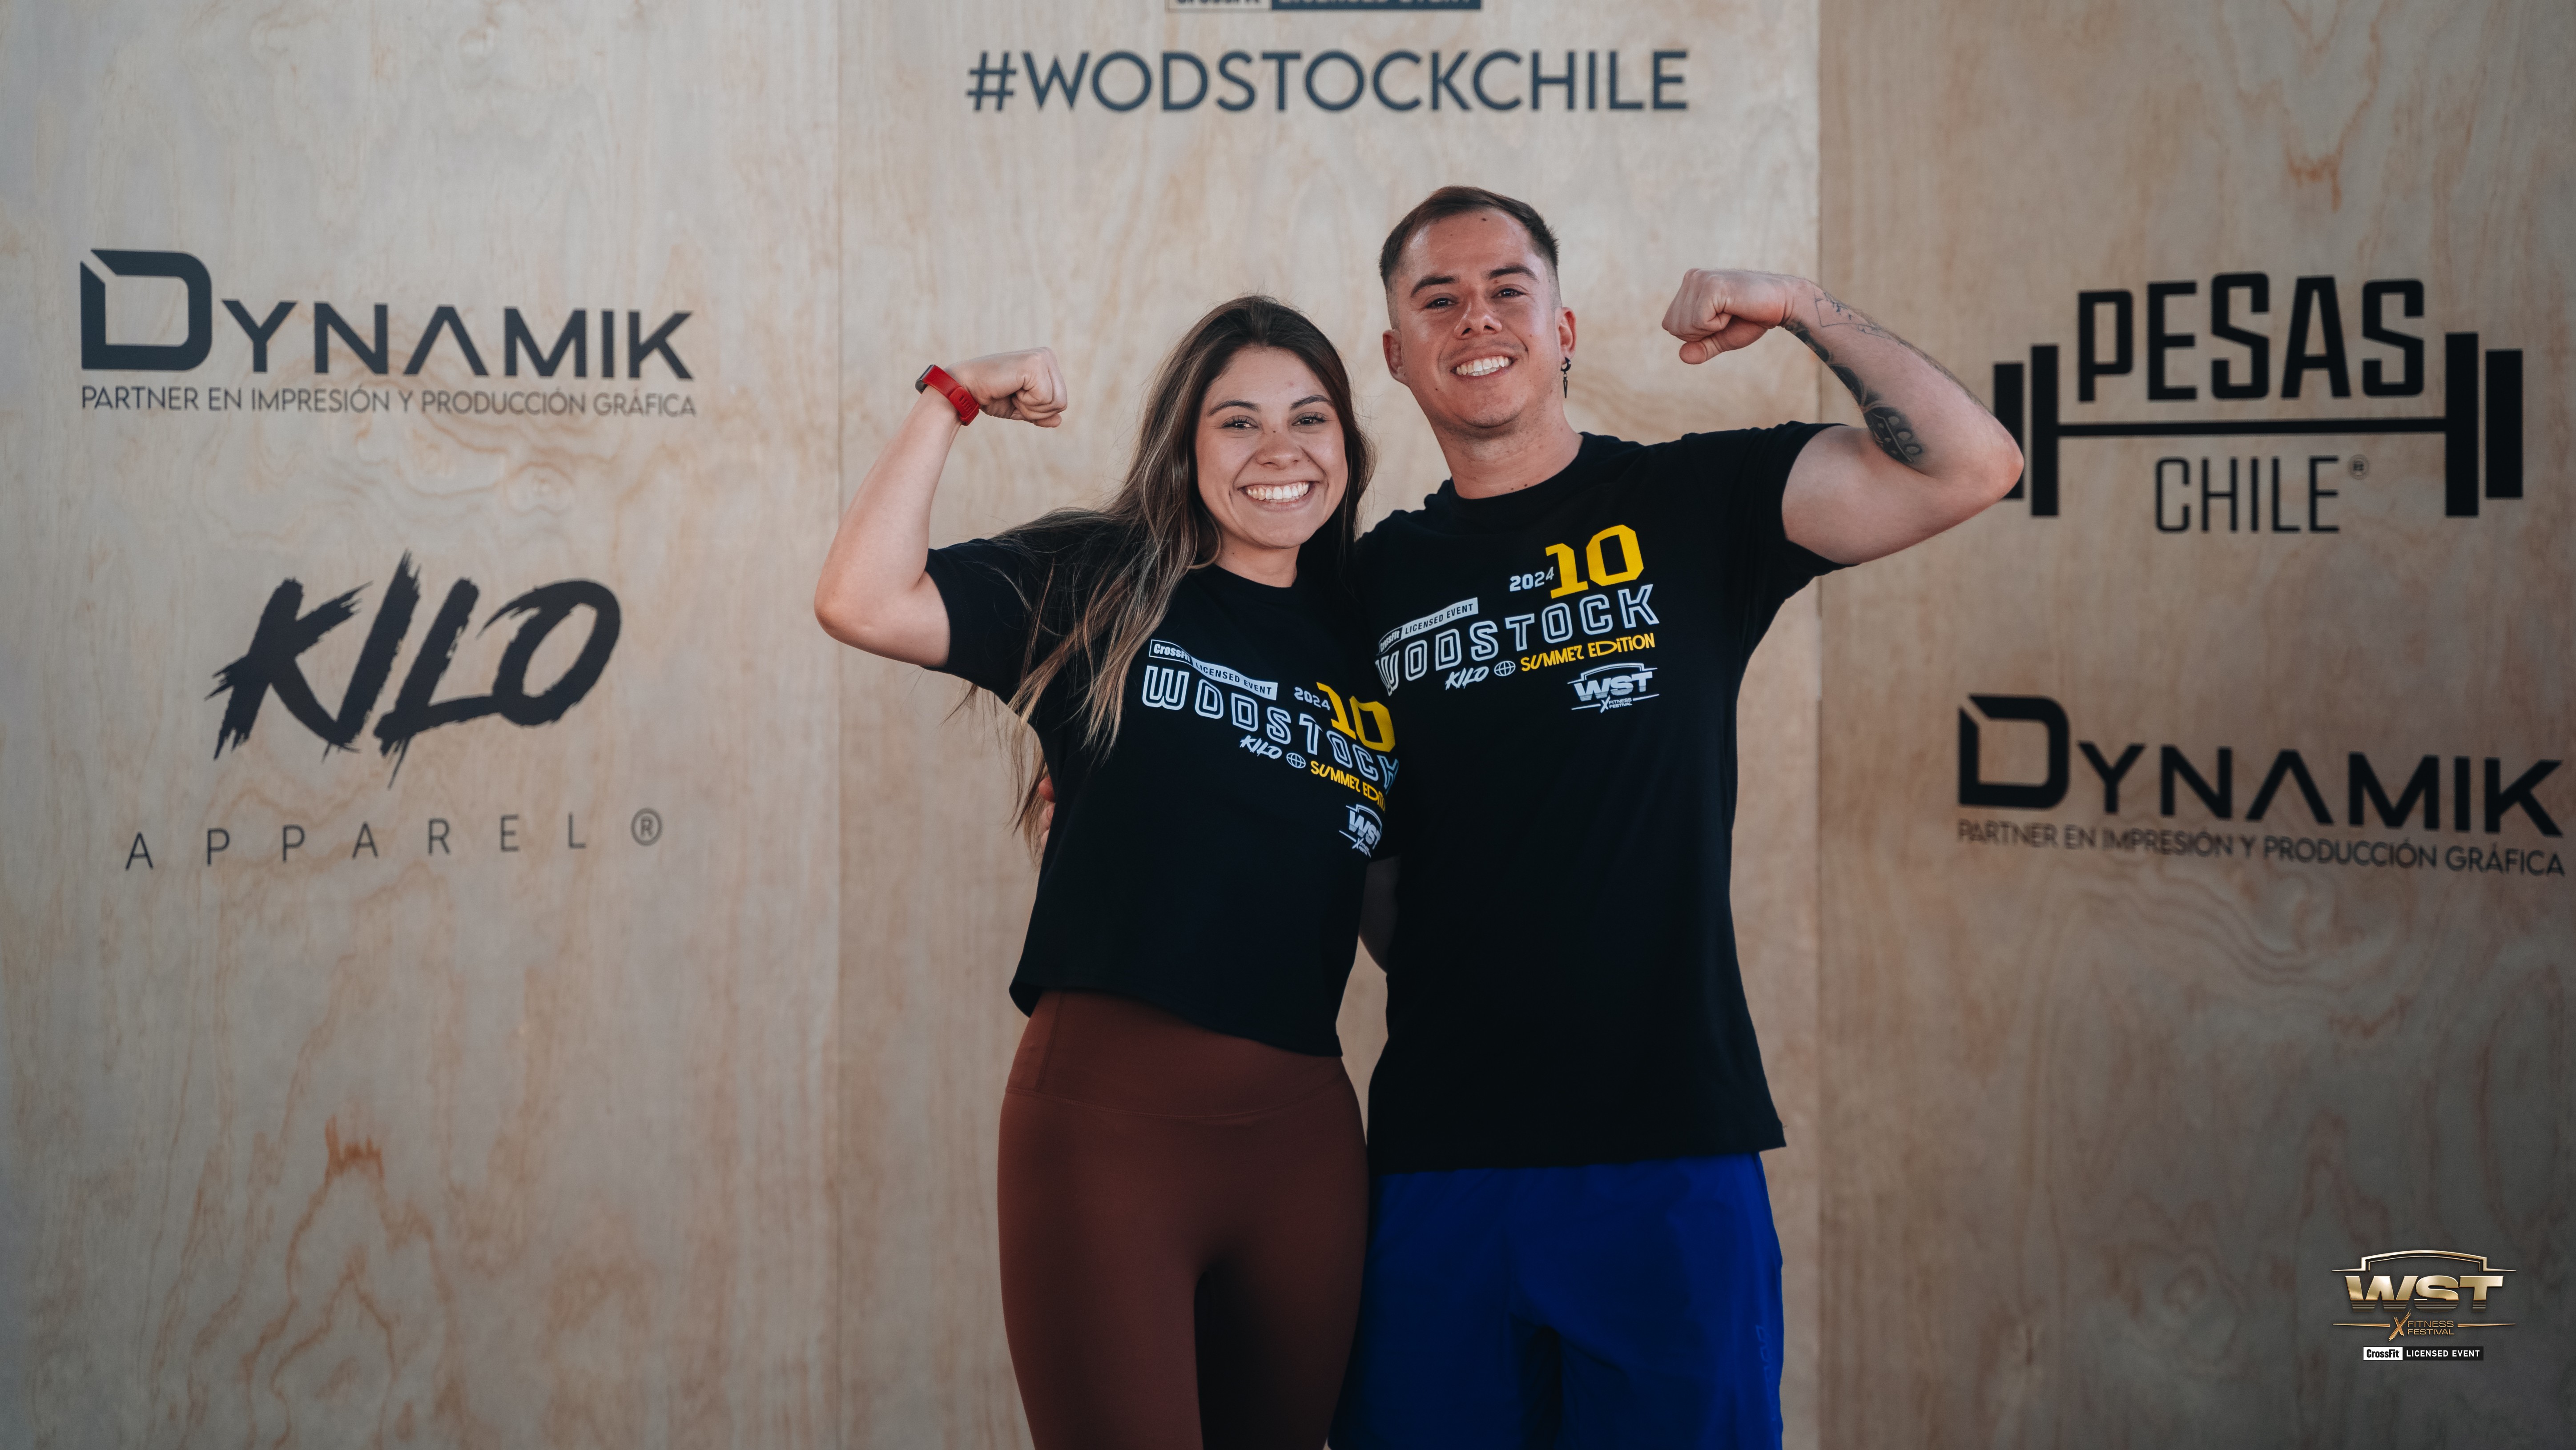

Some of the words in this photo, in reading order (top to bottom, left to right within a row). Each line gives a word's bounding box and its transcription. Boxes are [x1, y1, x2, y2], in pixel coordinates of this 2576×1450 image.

[965, 50, 1689, 112] #WODSTOCKCHILE
[80, 248, 694, 381] DYNAMIK
[2077, 271, 2425, 403] PESAS
[82, 385, 199, 411] PARTNER
[209, 386, 242, 412] EN
[252, 384, 390, 413] IMPRESIÓN
[399, 390, 414, 413] Y
[422, 386, 586, 415] PRODUCCIÓN
[593, 388, 696, 417] GRÁFICA
[1509, 566, 1554, 591] 2024
[1545, 524, 1644, 599] 10
[1375, 584, 1660, 697] WODSTOCK
[1380, 630, 1401, 652] CrossFit
[1405, 614, 1444, 635] LICENSED
[1446, 603, 1473, 619] EVENT
[204, 548, 621, 790] KILO
[1154, 643, 1191, 663] CrossFit
[1195, 662, 1240, 683] LICENSED
[1244, 679, 1272, 695] EVENT
[1445, 666, 1489, 691] KILO
[1574, 671, 1653, 702] WST
[1240, 735, 1282, 759] KILO
[1294, 687, 1331, 711] 2024
[1316, 682, 1396, 753] 10
[1958, 692, 2564, 839] DYNAMIK
[1958, 819, 2059, 848] PARTNER
[2064, 824, 2096, 850] EN
[2102, 827, 2233, 858] IMPRESIÓN
[2240, 835, 2258, 859] Y
[2264, 835, 2438, 869] PRODUCCIÓN
[2446, 843, 2566, 877] GRÁFICA
